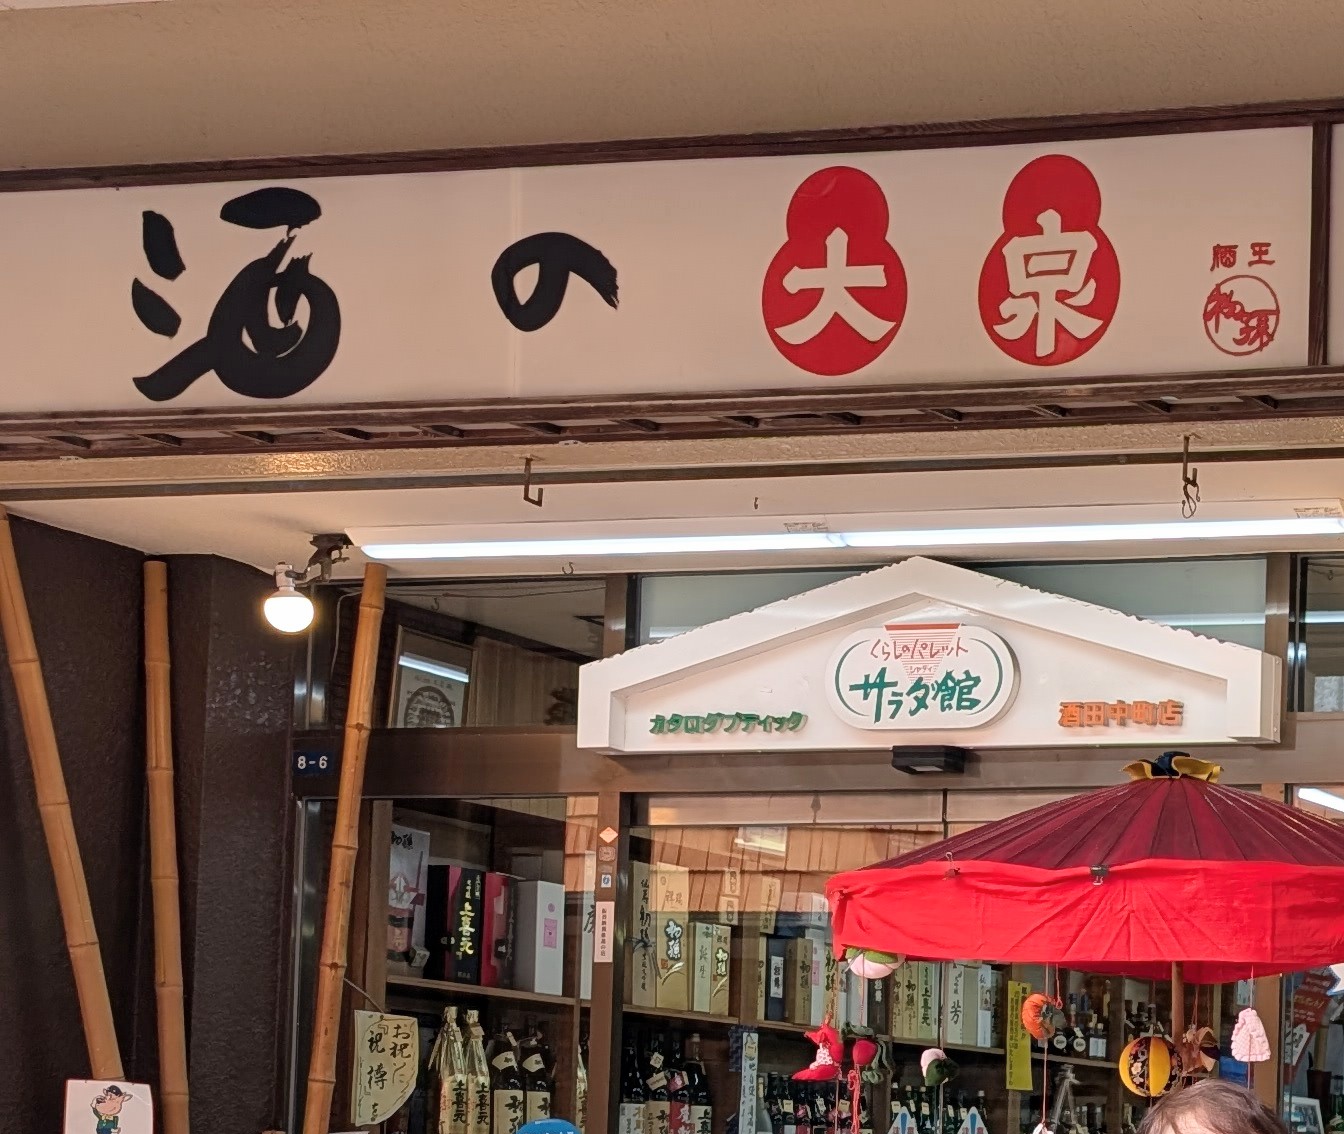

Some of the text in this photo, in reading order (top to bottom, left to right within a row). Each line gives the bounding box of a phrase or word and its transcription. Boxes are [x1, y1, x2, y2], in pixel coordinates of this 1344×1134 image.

[132, 187, 1106, 402] 酒の大泉
[870, 637, 968, 661] くらしのパレット
[909, 665, 933, 674] シャディ
[849, 666, 982, 724] サラダ館
[1058, 699, 1184, 728] 酒田中町店
[297, 755, 328, 770] 8-6
[458, 902, 475, 956] 上喜元
[921, 986, 932, 1027] 上喜元
[451, 1079, 468, 1124] 上喜元
[475, 1082, 490, 1126] 上喜元
